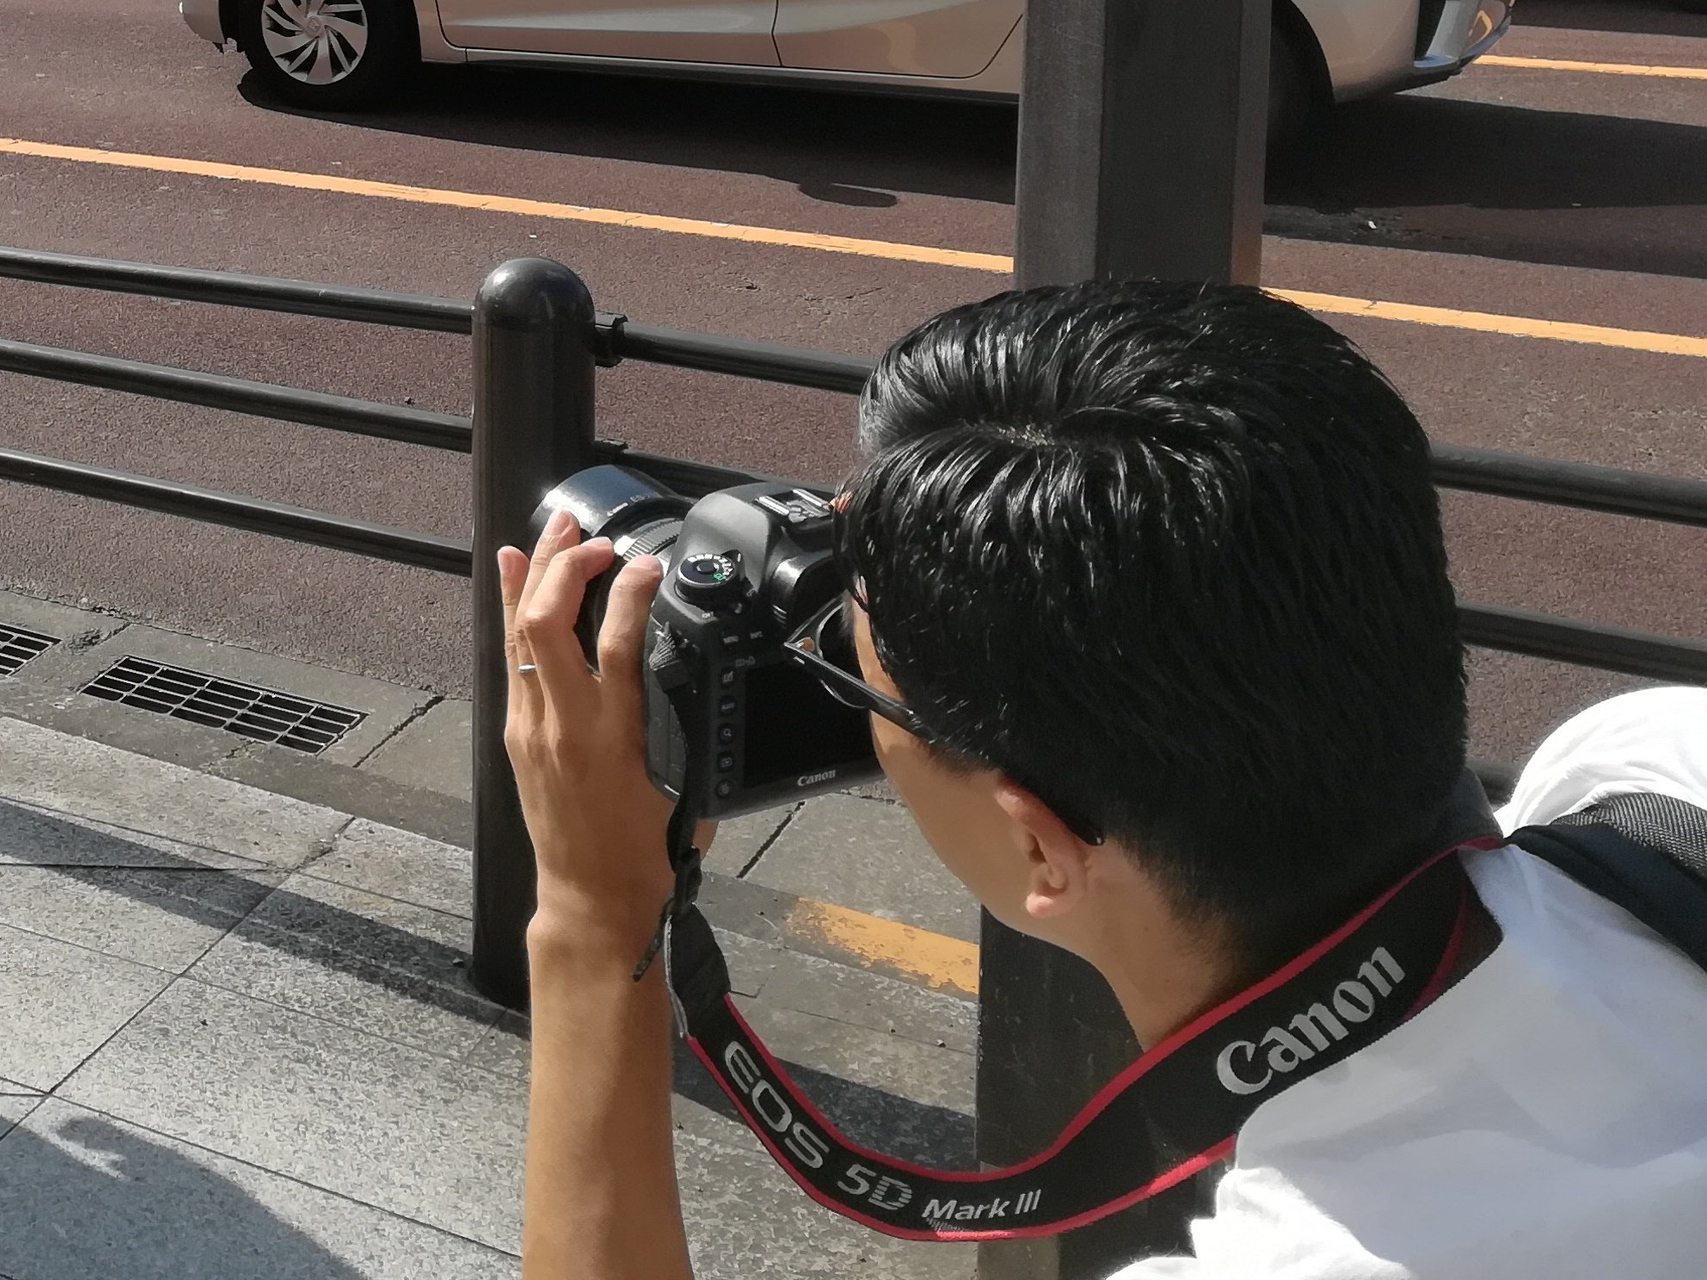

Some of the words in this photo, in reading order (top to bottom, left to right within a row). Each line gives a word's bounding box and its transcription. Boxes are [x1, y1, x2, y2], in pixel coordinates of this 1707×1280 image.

[797, 769, 836, 787] Canon
[1216, 946, 1406, 1095] Canon
[724, 1040, 830, 1169] EOS
[837, 1164, 913, 1210] 5D
[921, 1197, 1010, 1222] Mark
[1014, 1188, 1042, 1216] III
